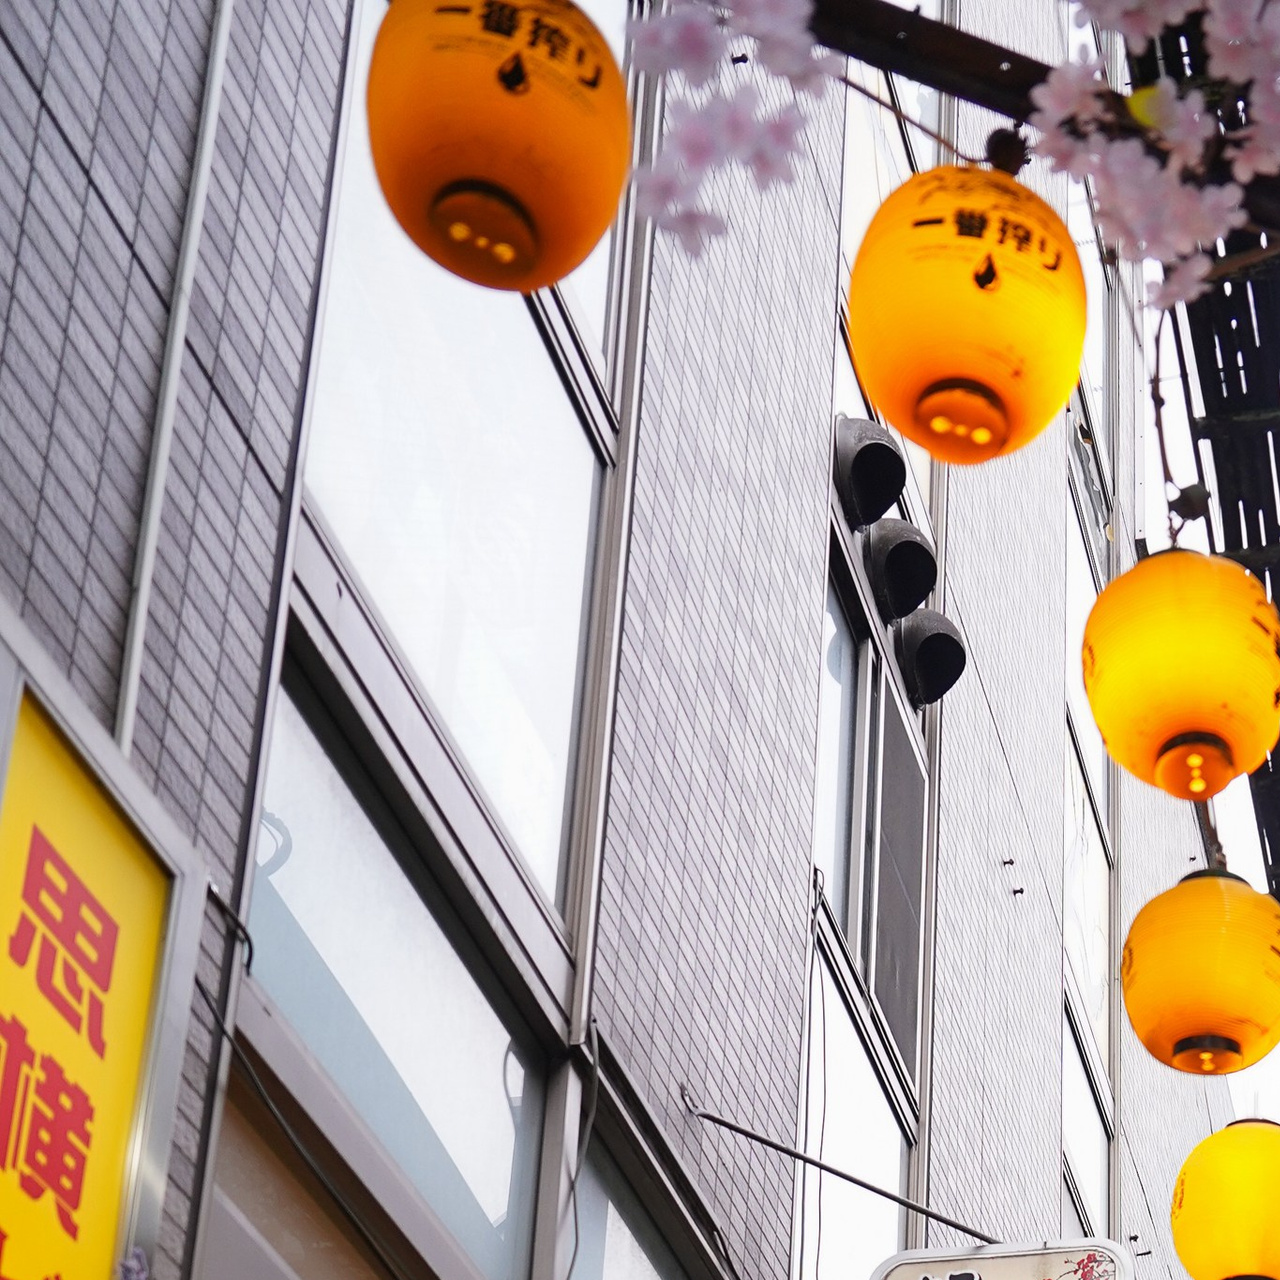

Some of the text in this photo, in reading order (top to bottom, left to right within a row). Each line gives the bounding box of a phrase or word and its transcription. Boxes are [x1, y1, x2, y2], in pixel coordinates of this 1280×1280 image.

[436, 0, 602, 90] 一番搾り
[912, 207, 1063, 272] 一番搾り
